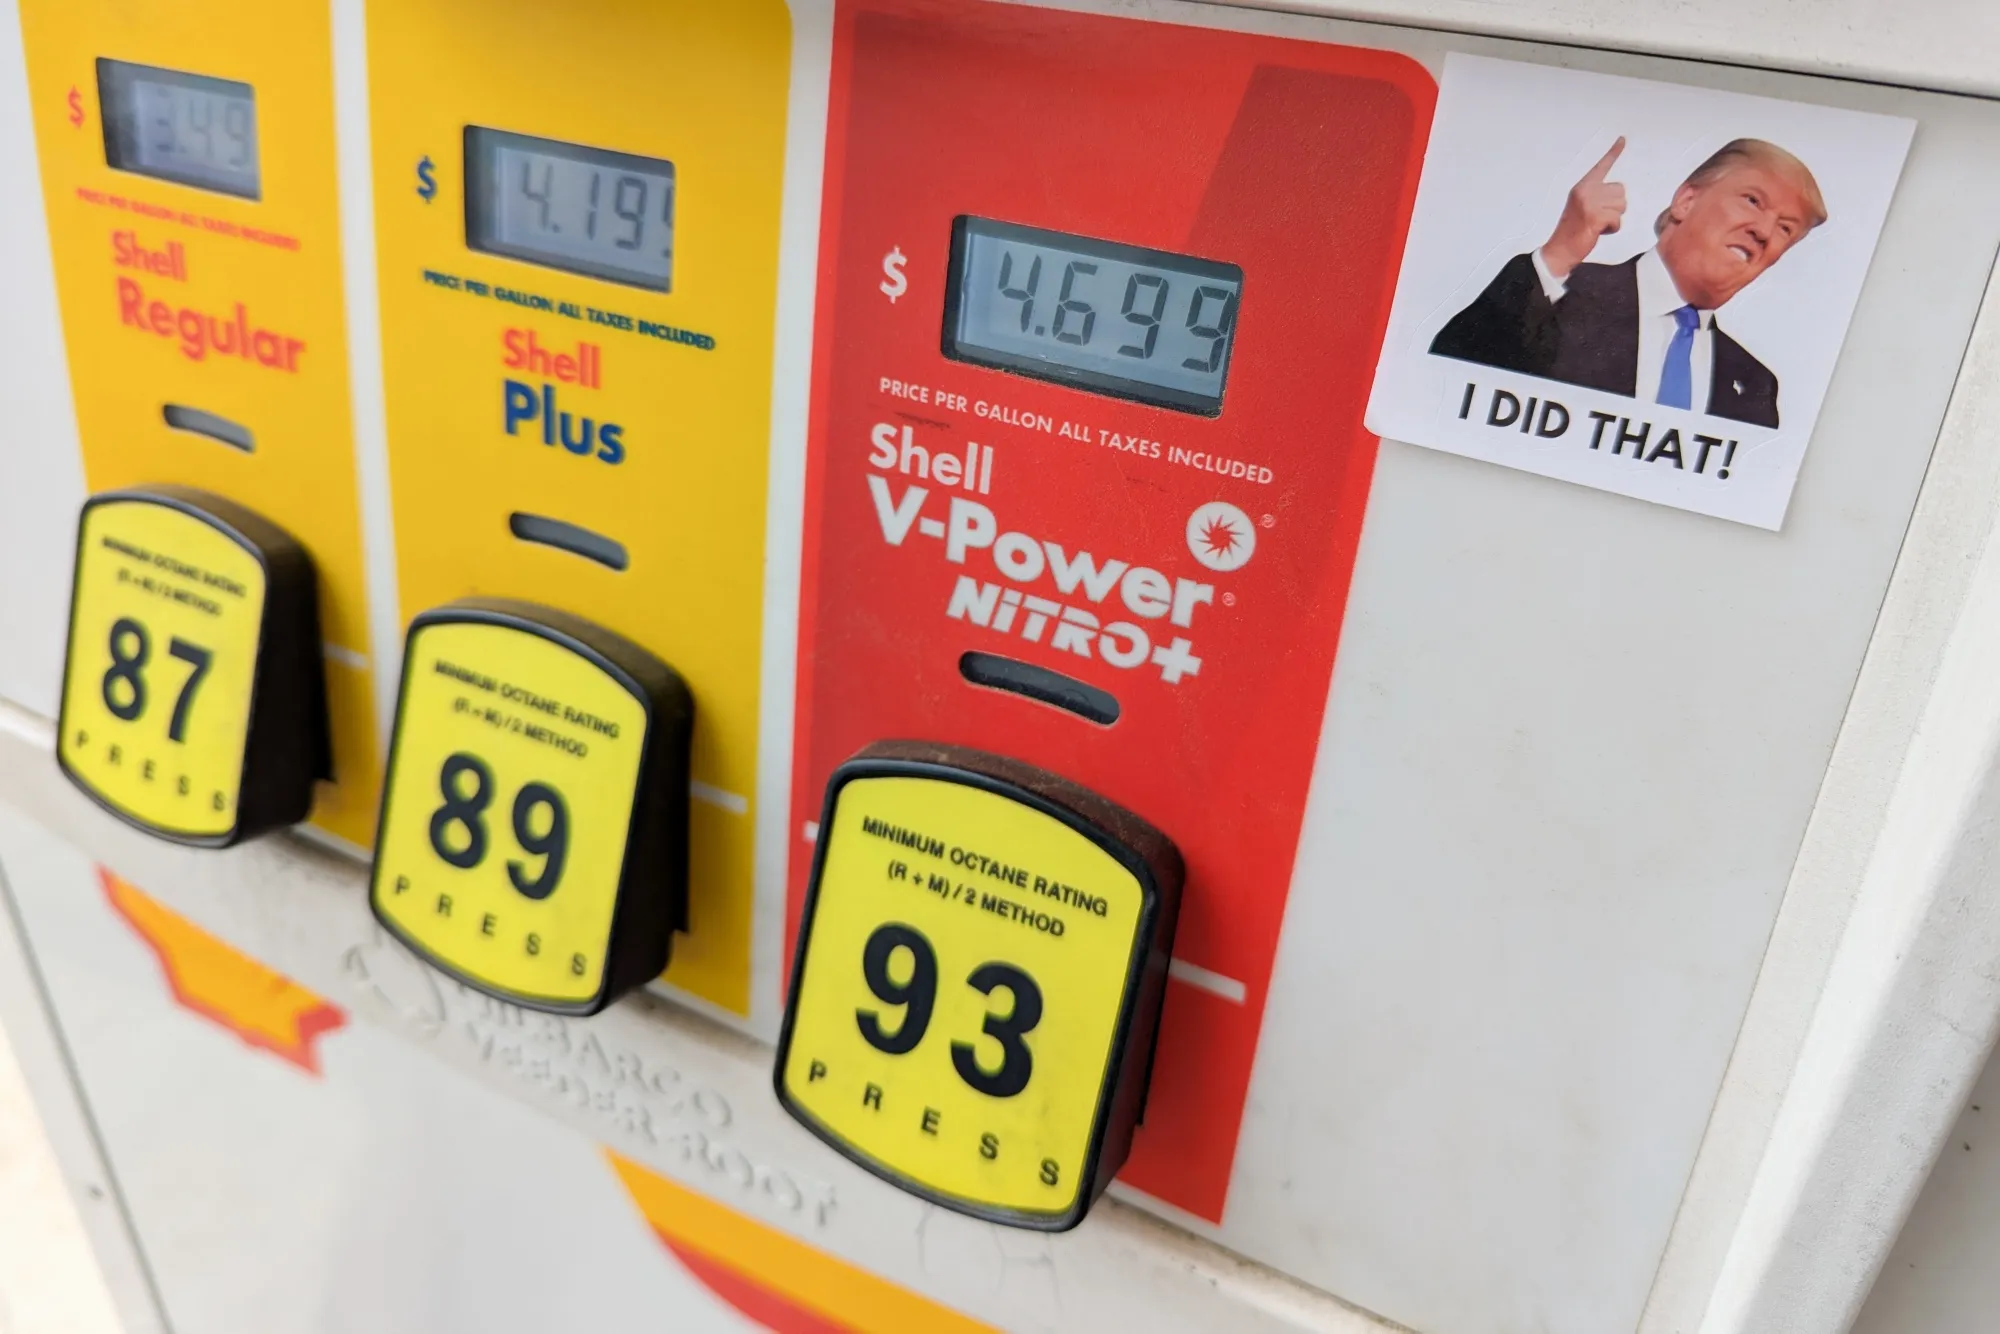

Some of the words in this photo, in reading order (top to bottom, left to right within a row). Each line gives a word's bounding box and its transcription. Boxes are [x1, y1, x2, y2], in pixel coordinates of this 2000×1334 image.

[416, 155, 437, 202] $
[112, 230, 187, 282] Shell
[116, 276, 307, 373] Regular
[879, 245, 907, 303] $
[998, 250, 1236, 373] 4.699
[502, 327, 601, 389] Shell
[503, 378, 626, 465] Plus
[868, 423, 994, 495] Shell
[879, 376, 929, 404] PRICE
[935, 390, 967, 414] PER
[974, 400, 1053, 434] GALLON
[1058, 421, 1091, 444] ALL
[1099, 429, 1161, 459] TAXES
[1167, 446, 1274, 485] INCLUDED
[1458, 383, 1476, 420] I
[1486, 388, 1570, 439] DID
[1588, 410, 1738, 480] THAT!
[866, 474, 1214, 628] V-Power
[103, 616, 214, 744] 87
[429, 751, 570, 900] 89
[862, 816, 944, 860] MINIMUM
[950, 847, 1029, 889] OCTANE
[1034, 877, 1108, 918] RATING
[964, 888, 976, 905] 2
[981, 895, 1065, 937] METHOD
[855, 921, 1044, 1098] 93
